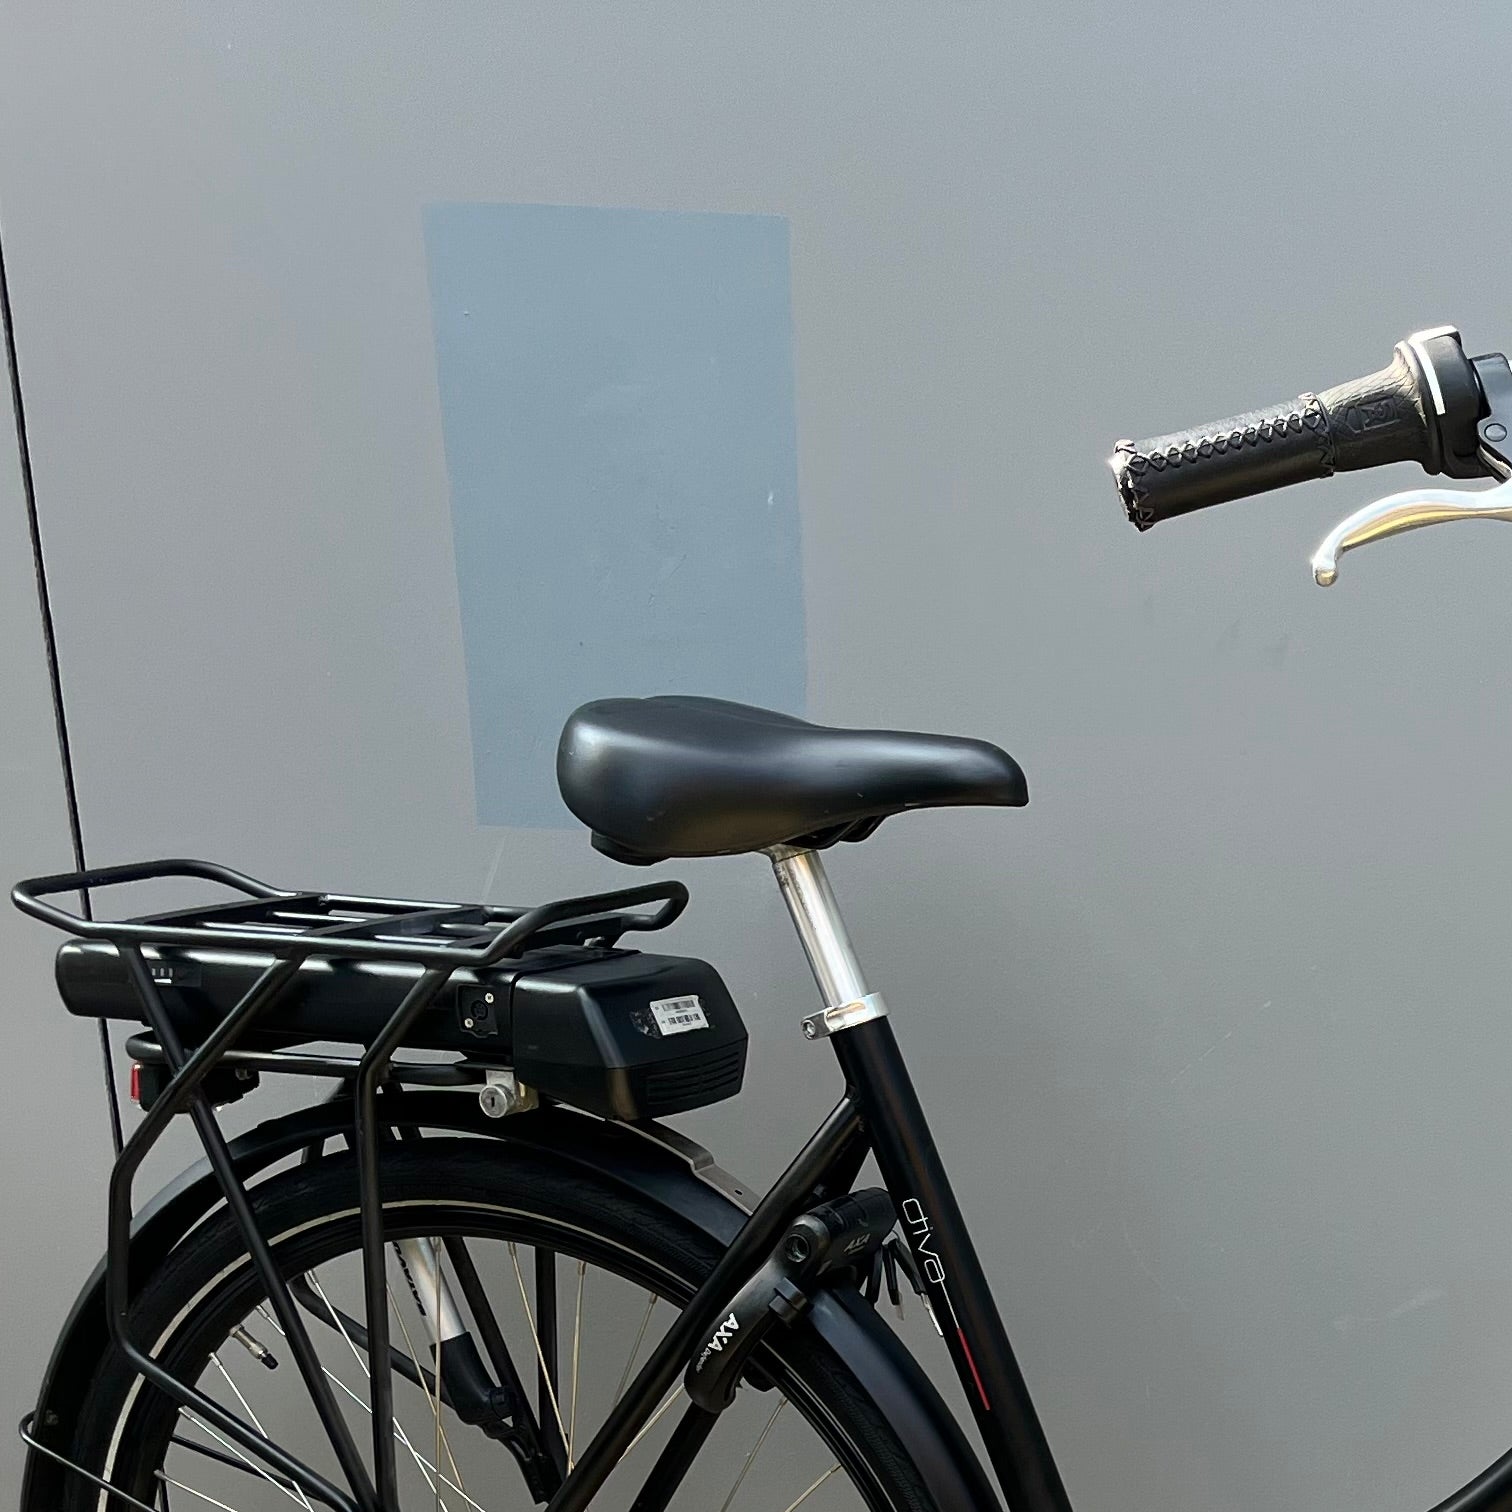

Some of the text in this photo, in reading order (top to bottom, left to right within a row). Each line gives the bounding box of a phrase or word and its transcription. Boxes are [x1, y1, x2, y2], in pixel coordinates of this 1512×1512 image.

[392, 1240, 427, 1317] BATAVU
[902, 1198, 946, 1284] diva
[707, 1311, 740, 1352] AXA
